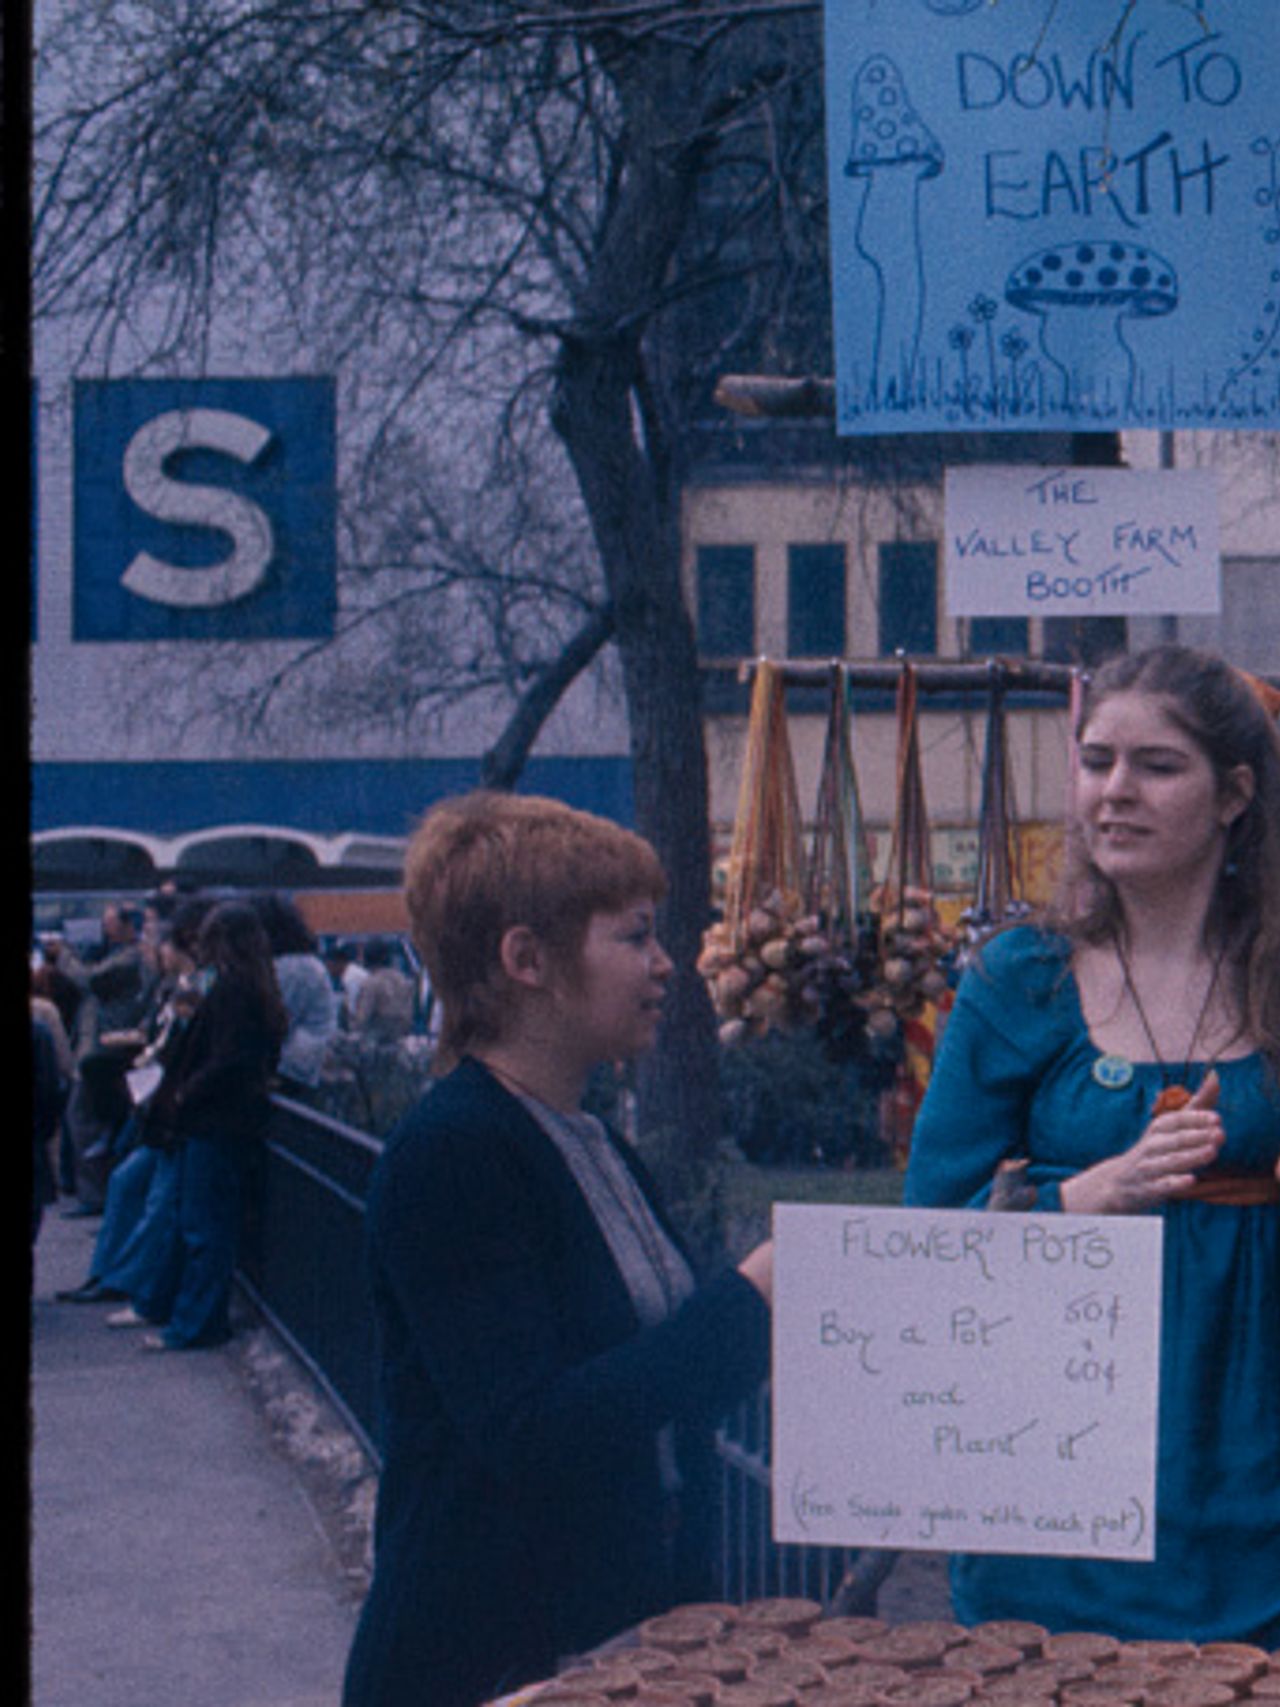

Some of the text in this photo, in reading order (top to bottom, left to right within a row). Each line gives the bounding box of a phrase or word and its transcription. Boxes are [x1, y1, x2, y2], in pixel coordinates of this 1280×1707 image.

[956, 30, 1241, 111] DOWN TO
[985, 132, 1229, 229] EARTH
[121, 408, 273, 606] S
[1025, 470, 1099, 504] THE
[955, 521, 1197, 567] VALLEY FARM
[1026, 563, 1151, 600] BOOTH
[1023, 1223, 1114, 1269] POTS
[819, 1306, 1013, 1374] Buy a Pot
[902, 1386, 964, 1406] and
[933, 1418, 1101, 1461] Plant it
[918, 1503, 969, 1539] given
[980, 1501, 1028, 1526] with
[1034, 1510, 1085, 1533] each
[1091, 1496, 1145, 1547] pot)
